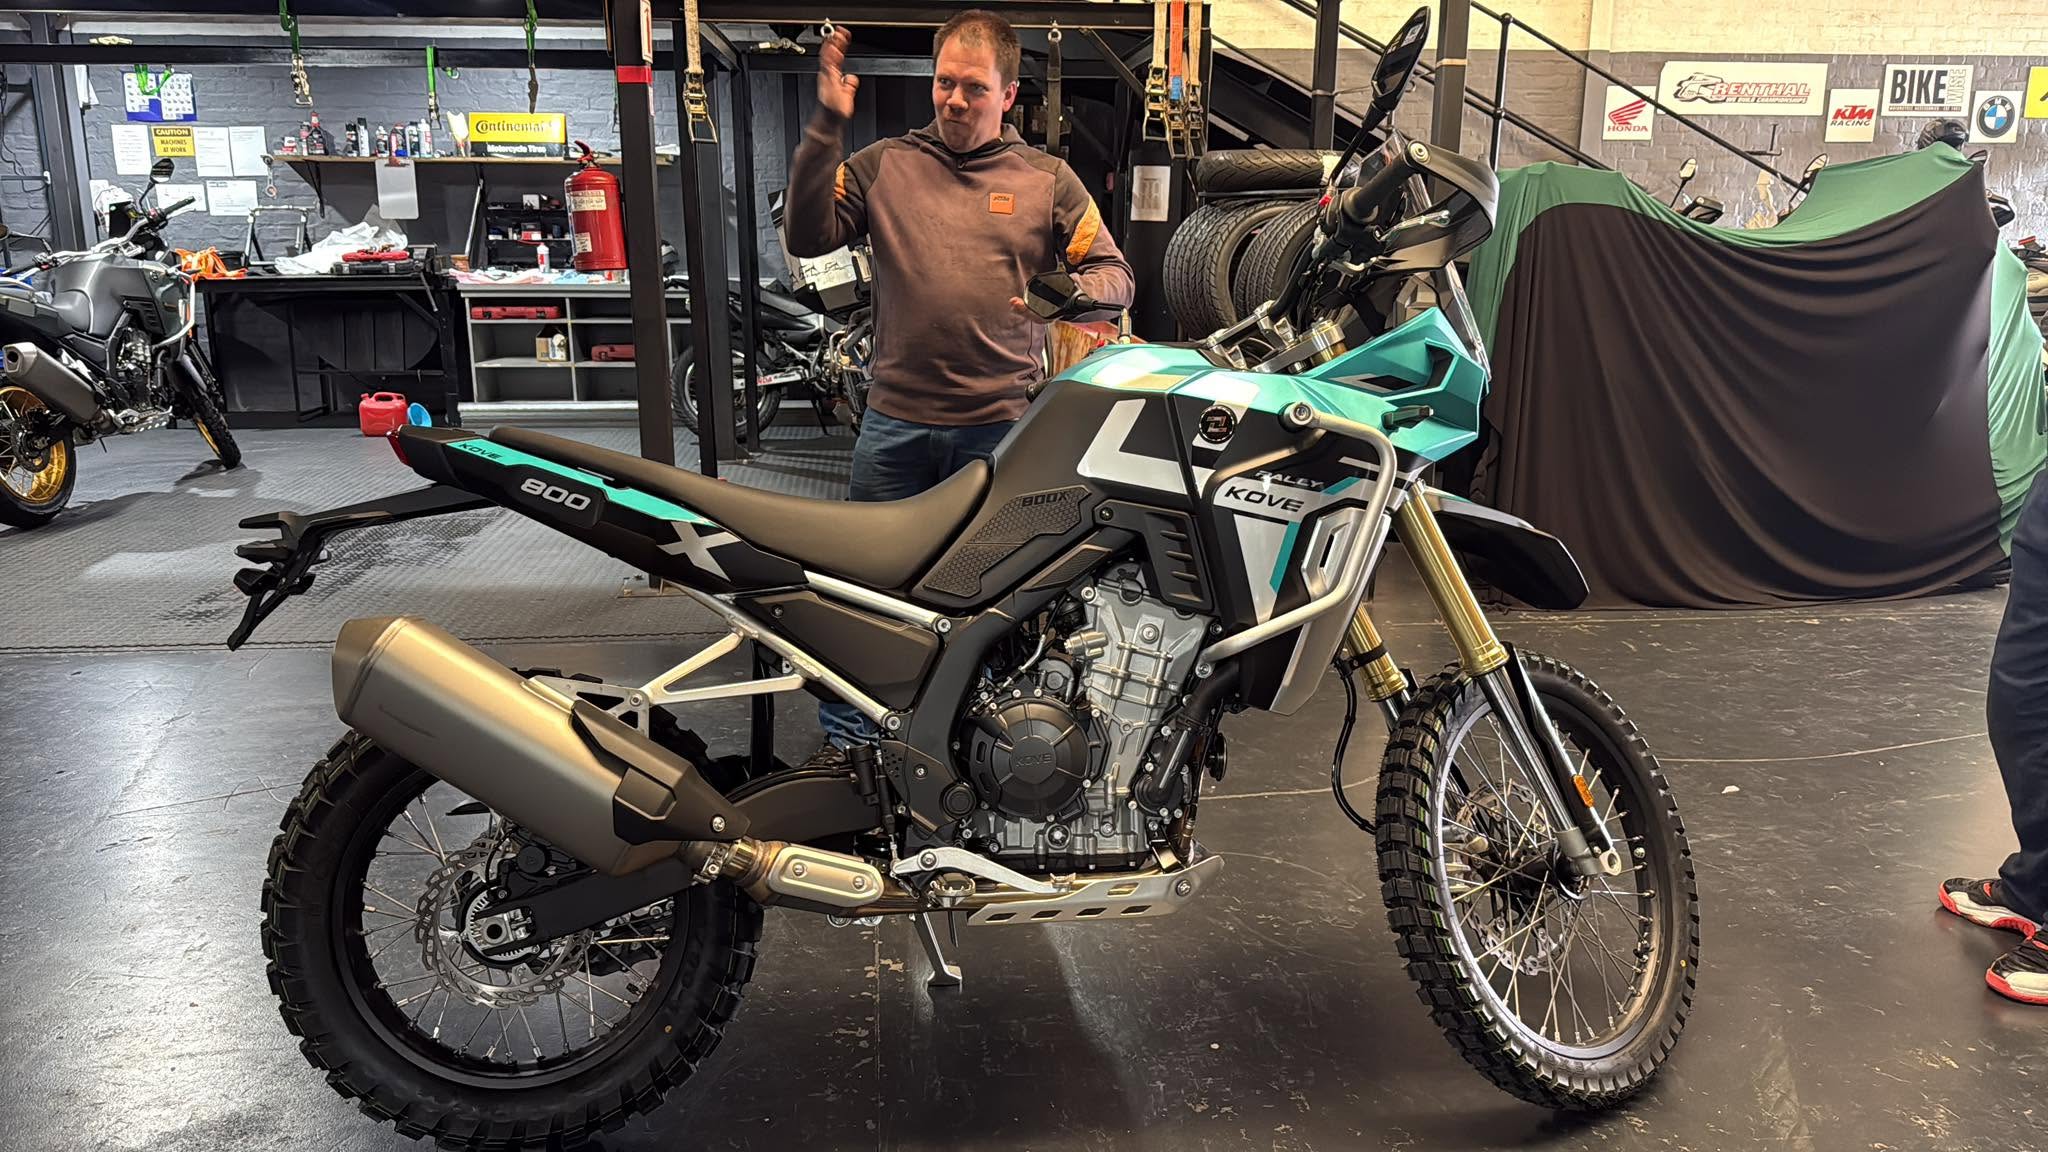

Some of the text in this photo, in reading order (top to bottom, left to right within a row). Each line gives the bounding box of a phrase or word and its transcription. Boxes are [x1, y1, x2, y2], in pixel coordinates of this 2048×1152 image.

[1711, 82, 1811, 97] RENTHAL
[1889, 69, 1948, 104] BIKE
[1946, 68, 1967, 104] WISE
[1832, 105, 1875, 120] KTM
[487, 144, 527, 154] Motorcycle
[459, 442, 502, 460] KOVE
[520, 478, 591, 511] 800
[1021, 491, 1069, 507] 800X
[1224, 486, 1304, 513] KOVE
[656, 521, 741, 582] X
